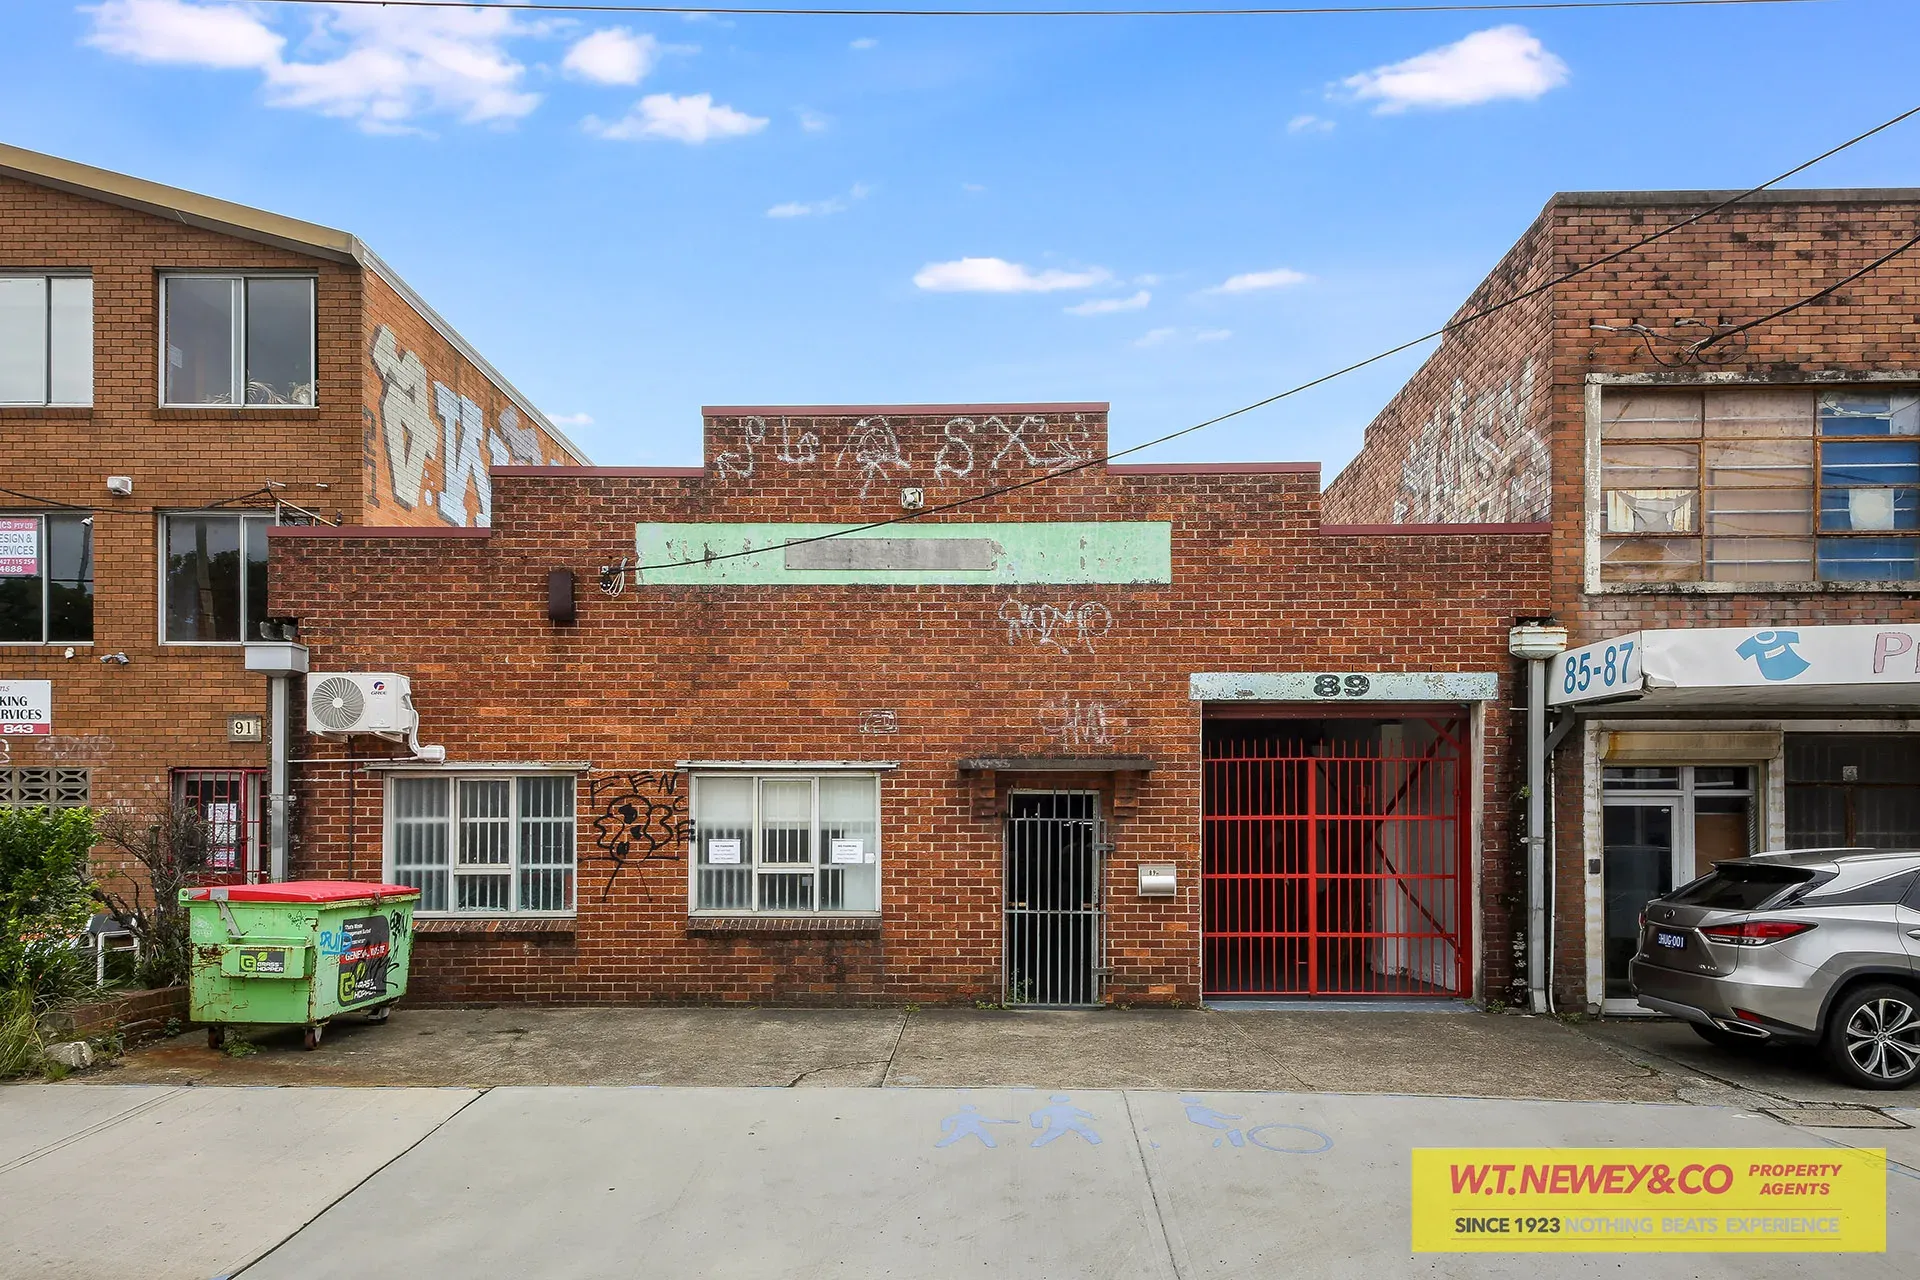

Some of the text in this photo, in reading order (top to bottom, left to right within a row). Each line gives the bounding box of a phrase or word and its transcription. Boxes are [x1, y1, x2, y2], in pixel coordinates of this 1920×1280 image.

[26, 534, 32, 543] &
[1564, 641, 1634, 694] 85-87
[1313, 674, 1371, 697] 89
[3, 724, 34, 734] 843
[235, 721, 252, 735] 91
